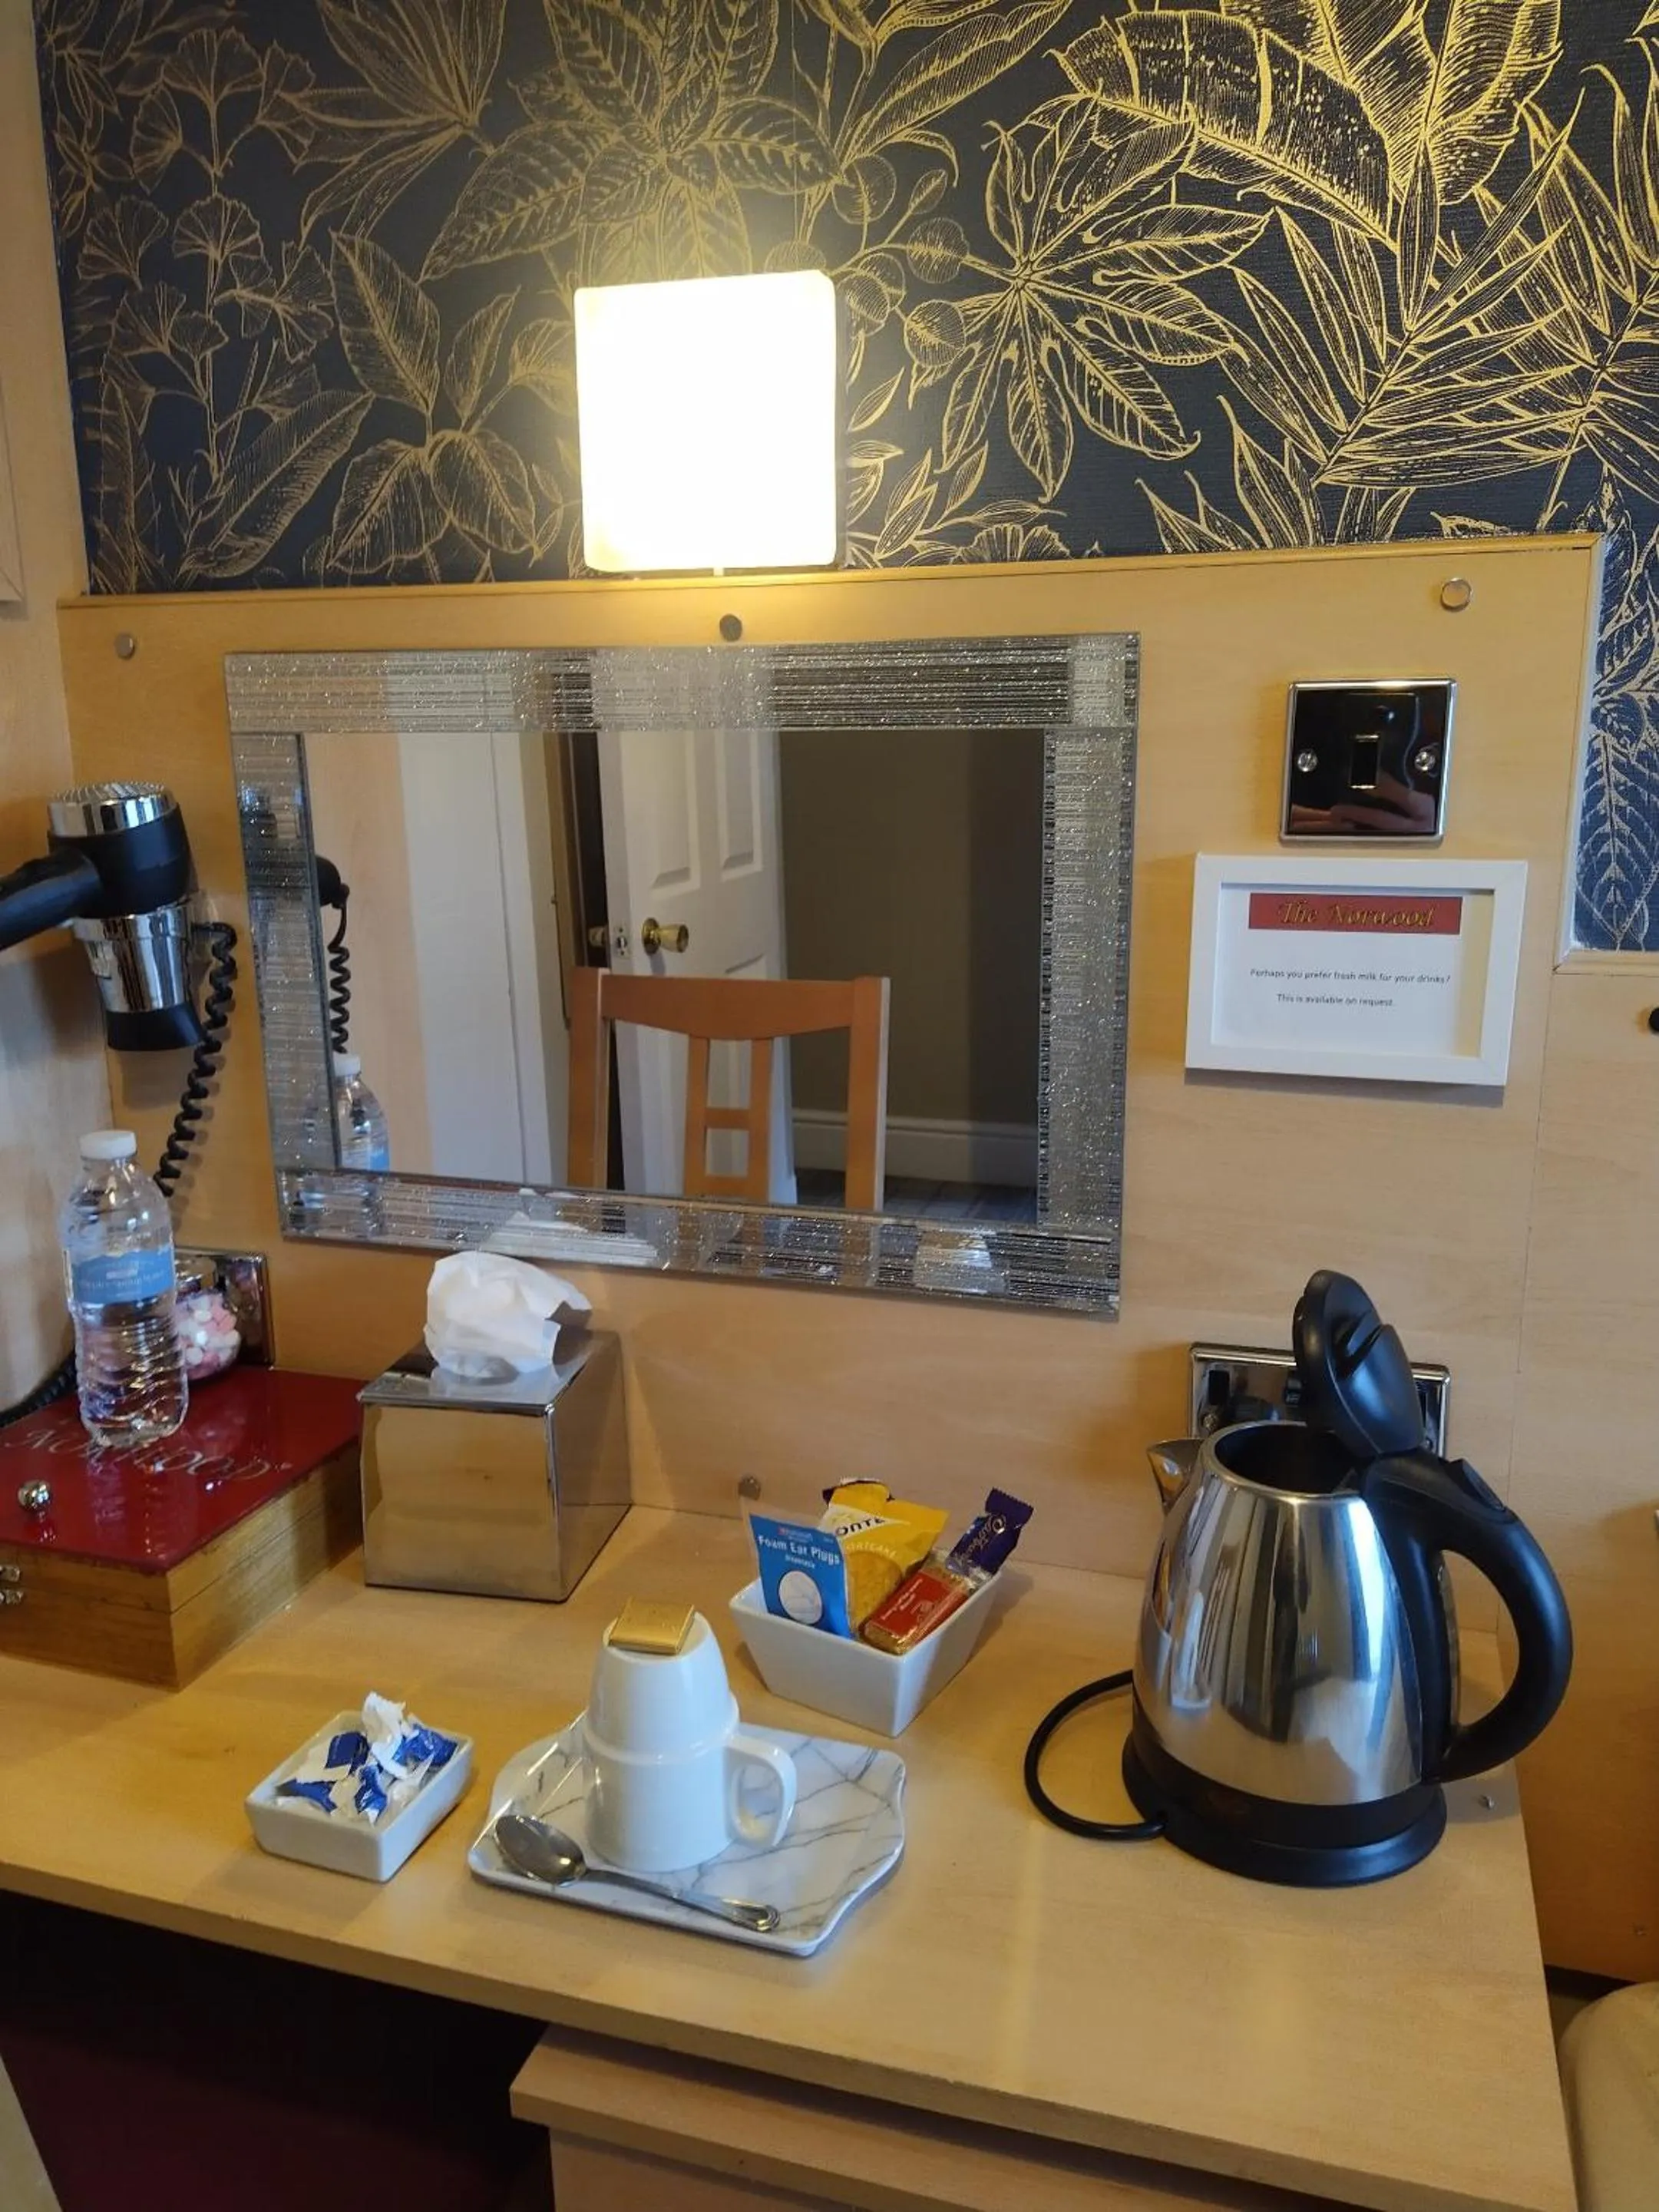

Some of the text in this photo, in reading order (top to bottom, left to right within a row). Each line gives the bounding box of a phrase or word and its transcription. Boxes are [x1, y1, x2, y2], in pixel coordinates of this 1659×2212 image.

[1277, 898, 1438, 928] The Norwood
[1249, 968, 1286, 978] Perhaps
[1286, 971, 1304, 980] you
[1304, 969, 1333, 980] prefer
[1333, 970, 1357, 980] fresh
[1357, 971, 1376, 980] milk
[1379, 972, 1393, 981] for
[1394, 974, 1415, 984] your
[1276, 993, 1294, 1002] This
[1305, 996, 1343, 1004] available
[1344, 997, 1358, 1006] on
[758, 1534, 788, 1551] Foam
[789, 1541, 808, 1556] Ear
[810, 1546, 841, 1566] Plugs
